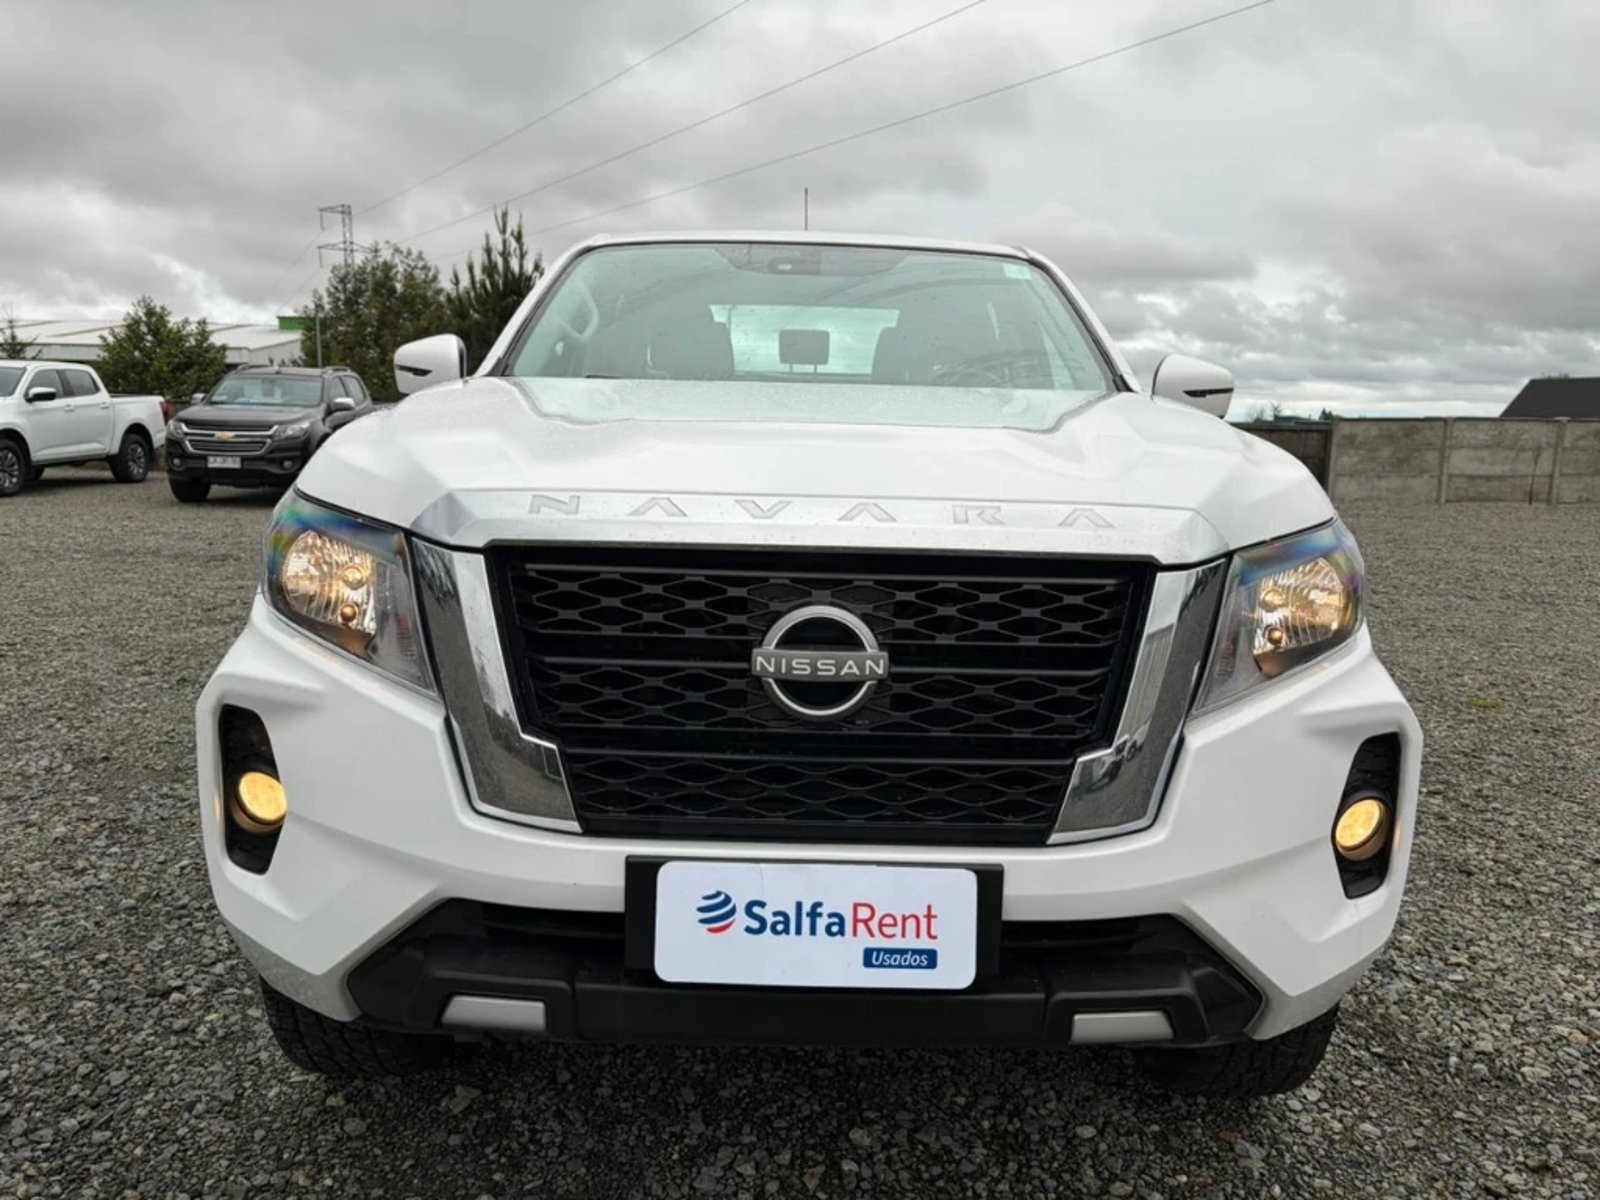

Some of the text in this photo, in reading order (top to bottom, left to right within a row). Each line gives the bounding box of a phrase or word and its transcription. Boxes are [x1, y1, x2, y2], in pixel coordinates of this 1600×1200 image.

[528, 494, 1117, 528] NAVARA
[756, 655, 884, 676] NISSAN
[871, 950, 928, 967] Usados
